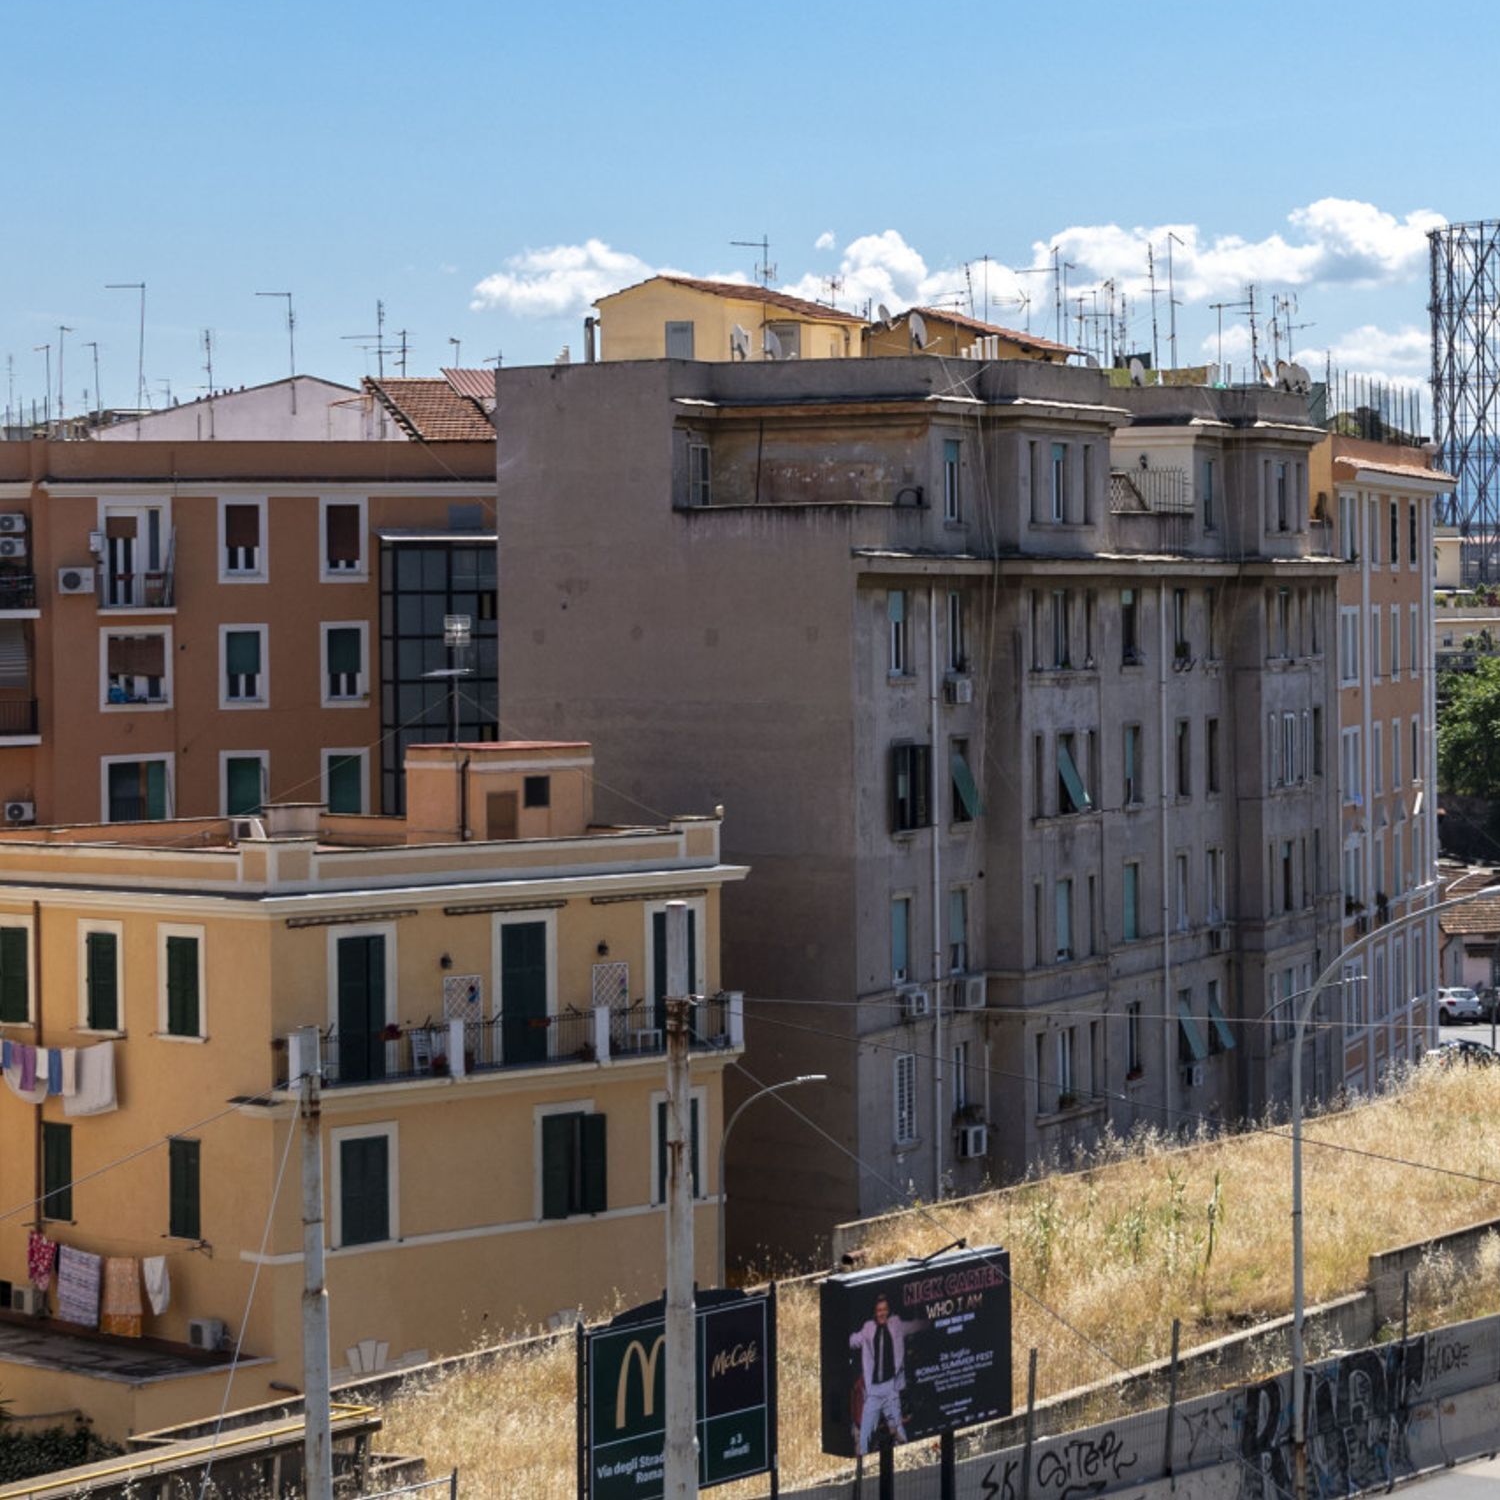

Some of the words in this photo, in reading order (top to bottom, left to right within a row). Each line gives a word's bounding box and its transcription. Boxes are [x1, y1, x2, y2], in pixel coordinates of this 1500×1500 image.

[904, 1275, 944, 1307] NICK
[944, 1264, 1004, 1295] CARTER
[926, 1299, 954, 1319] WHO
[967, 1292, 983, 1309] AM
[976, 1350, 994, 1361] FEST
[597, 1464, 613, 1479] Via
[614, 1456, 638, 1475] degli
[639, 1451, 664, 1468] Strad
[636, 1468, 663, 1484] Roma
